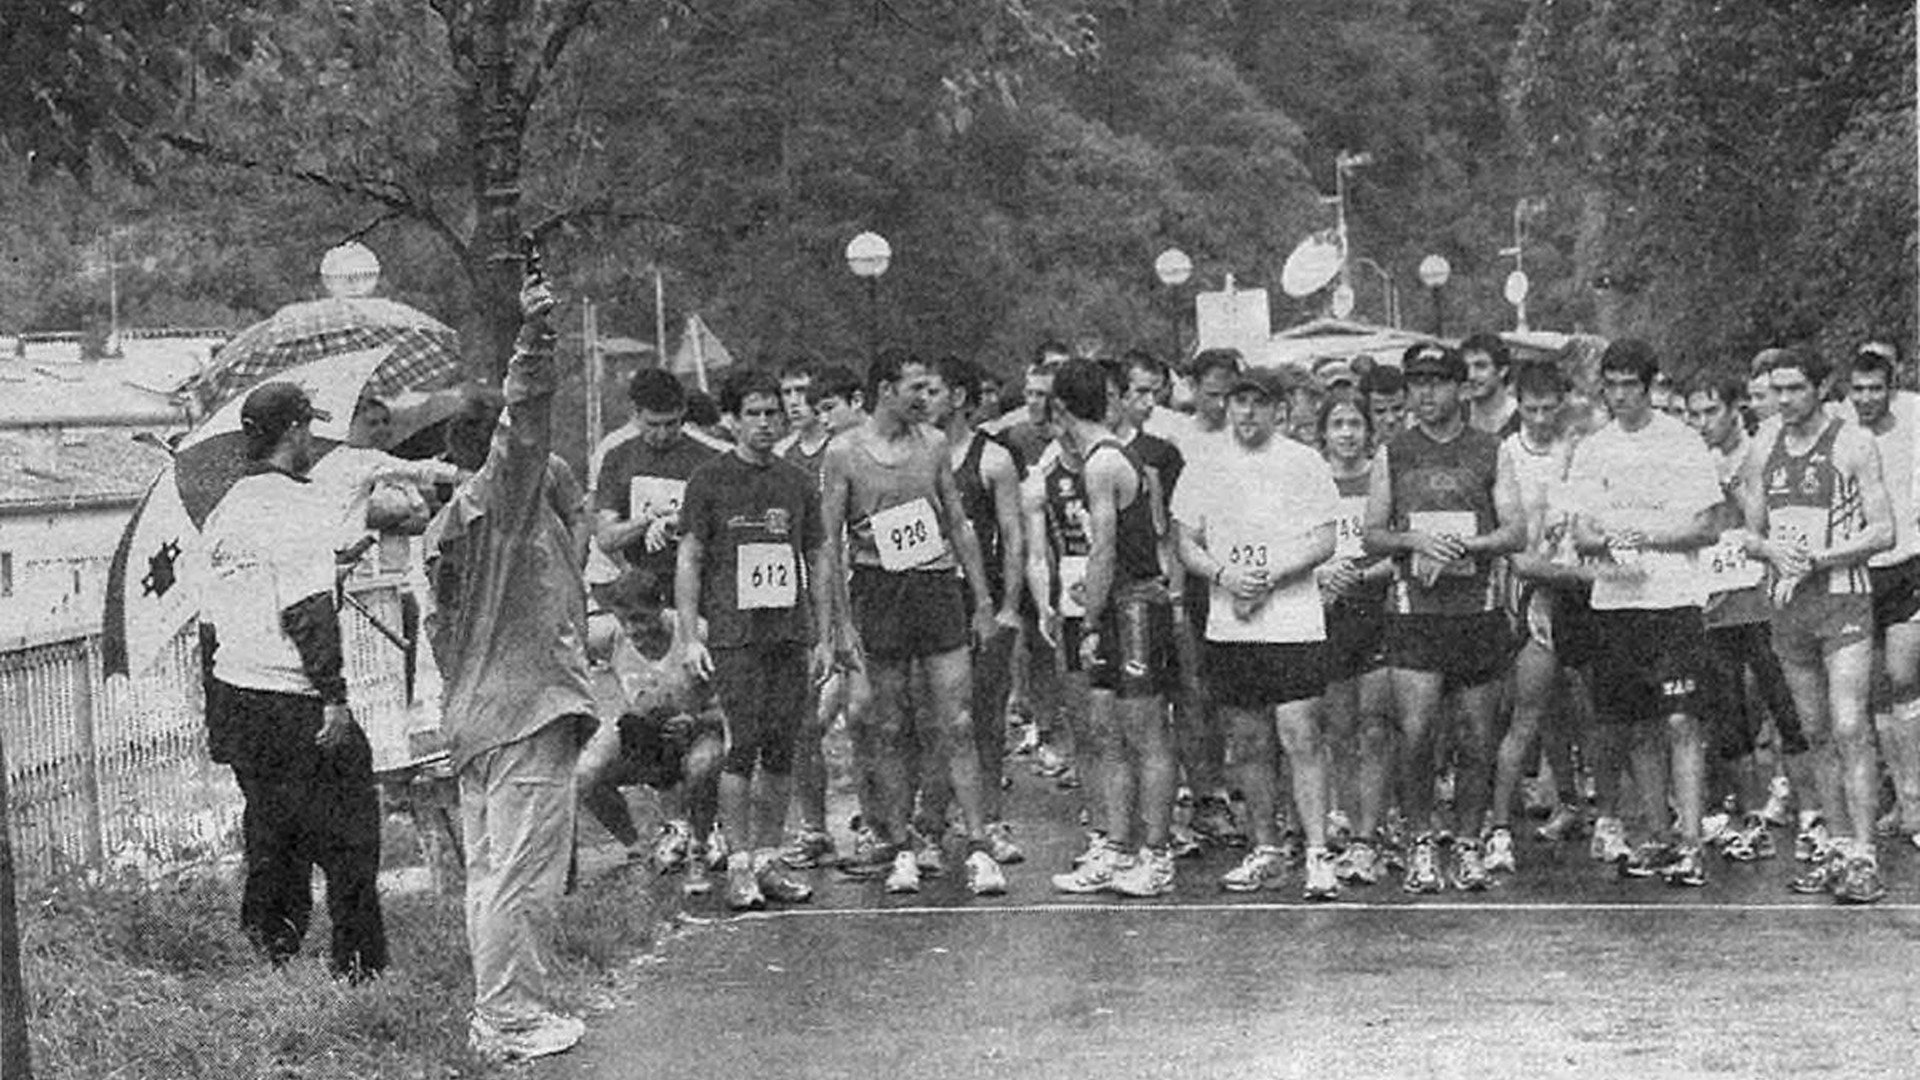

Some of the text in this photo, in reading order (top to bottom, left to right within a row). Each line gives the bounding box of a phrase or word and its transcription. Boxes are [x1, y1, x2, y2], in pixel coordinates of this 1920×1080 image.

[890, 518, 928, 551] 920
[1229, 544, 1268, 567] 623
[752, 565, 788, 589] 612
